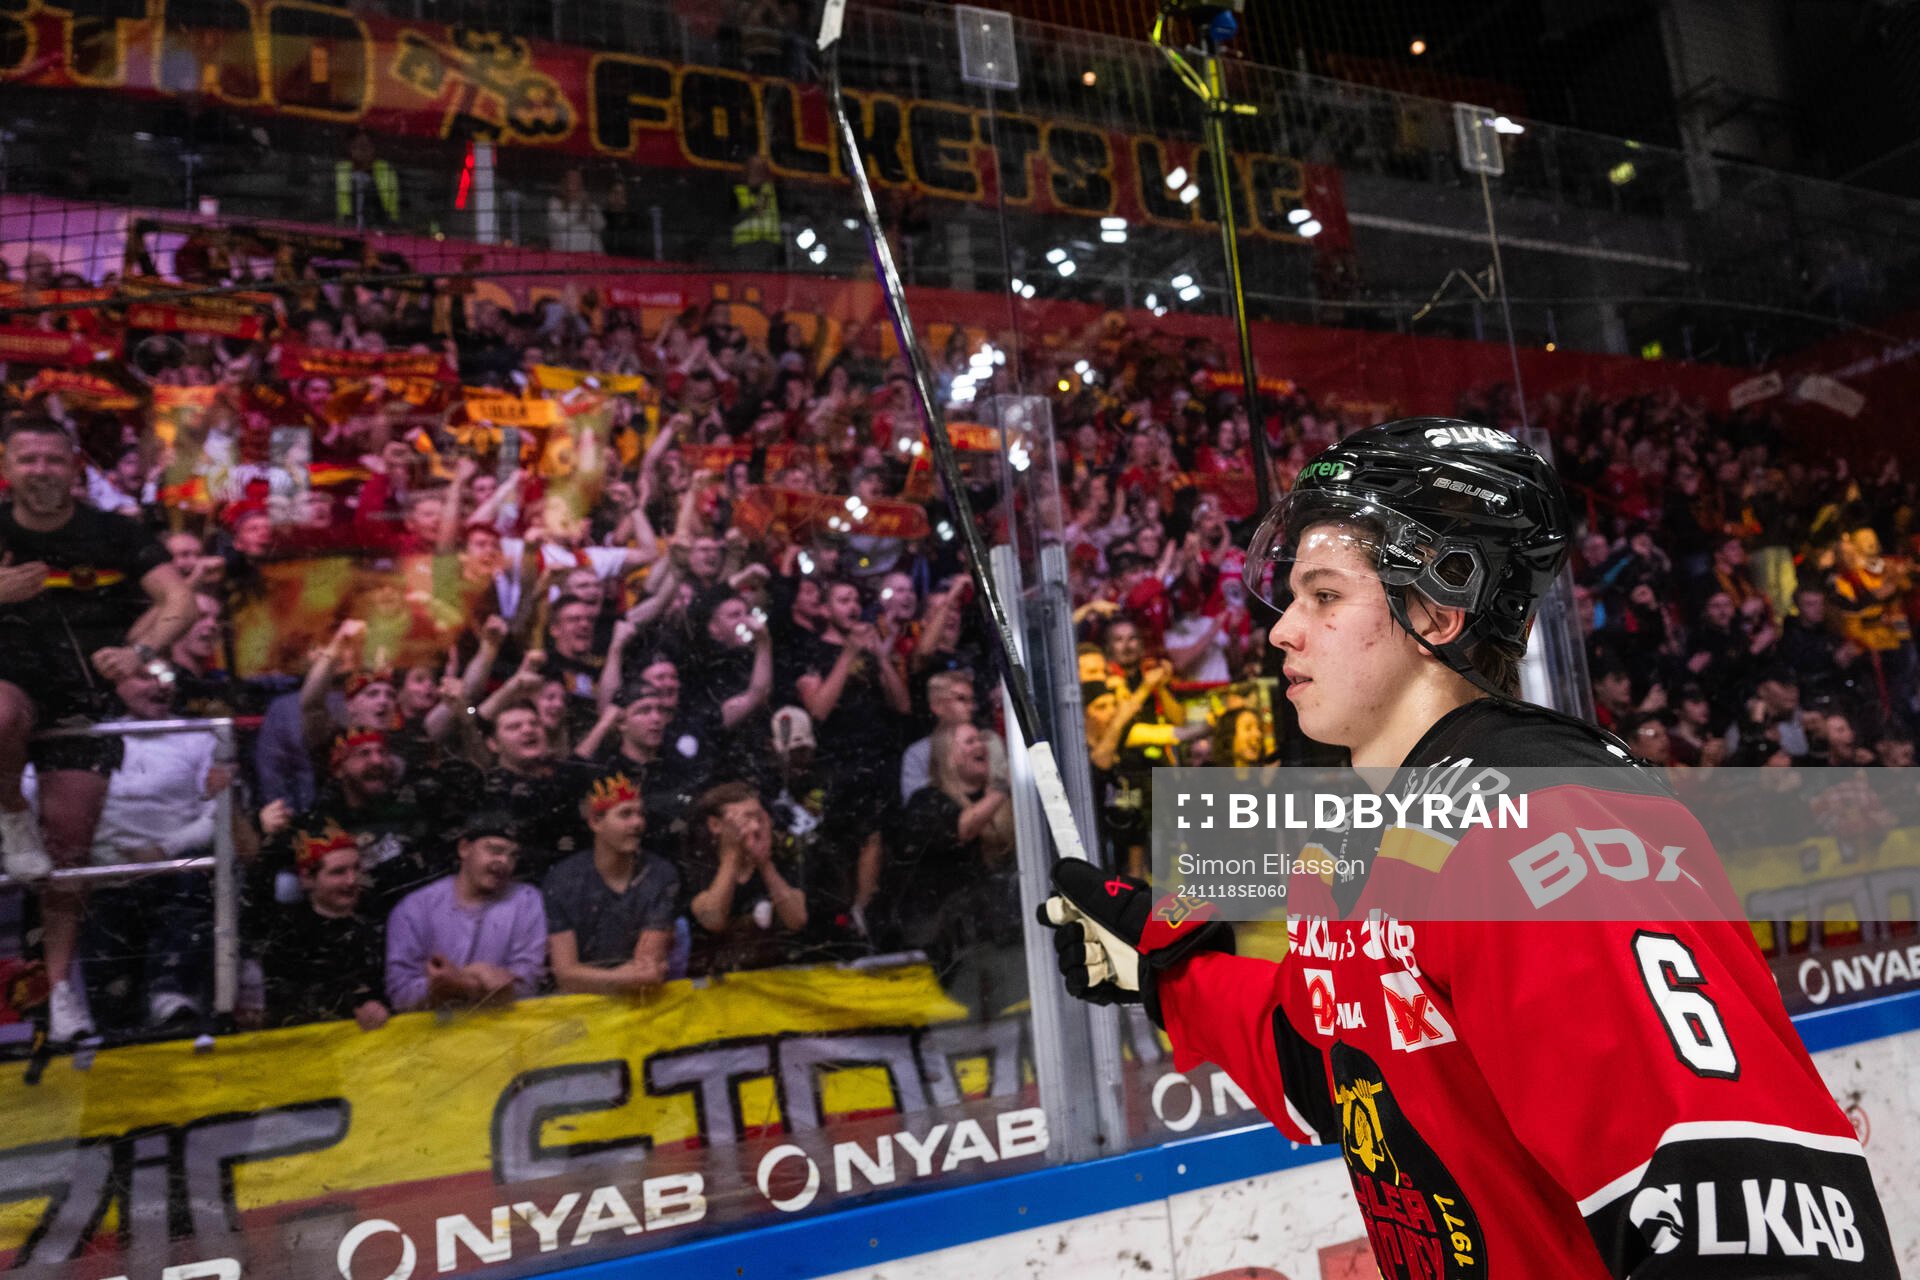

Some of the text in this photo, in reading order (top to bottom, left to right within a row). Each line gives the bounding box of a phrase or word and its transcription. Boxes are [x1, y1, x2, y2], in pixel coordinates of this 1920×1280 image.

[587, 52, 1115, 217] FOLKETS
[1631, 929, 1741, 1081] 6
[834, 1107, 1051, 1193] NYAB
[436, 1172, 708, 1273] NYAB
[1432, 1192, 1475, 1268] 1977
[1696, 1178, 1865, 1263] LKAB
